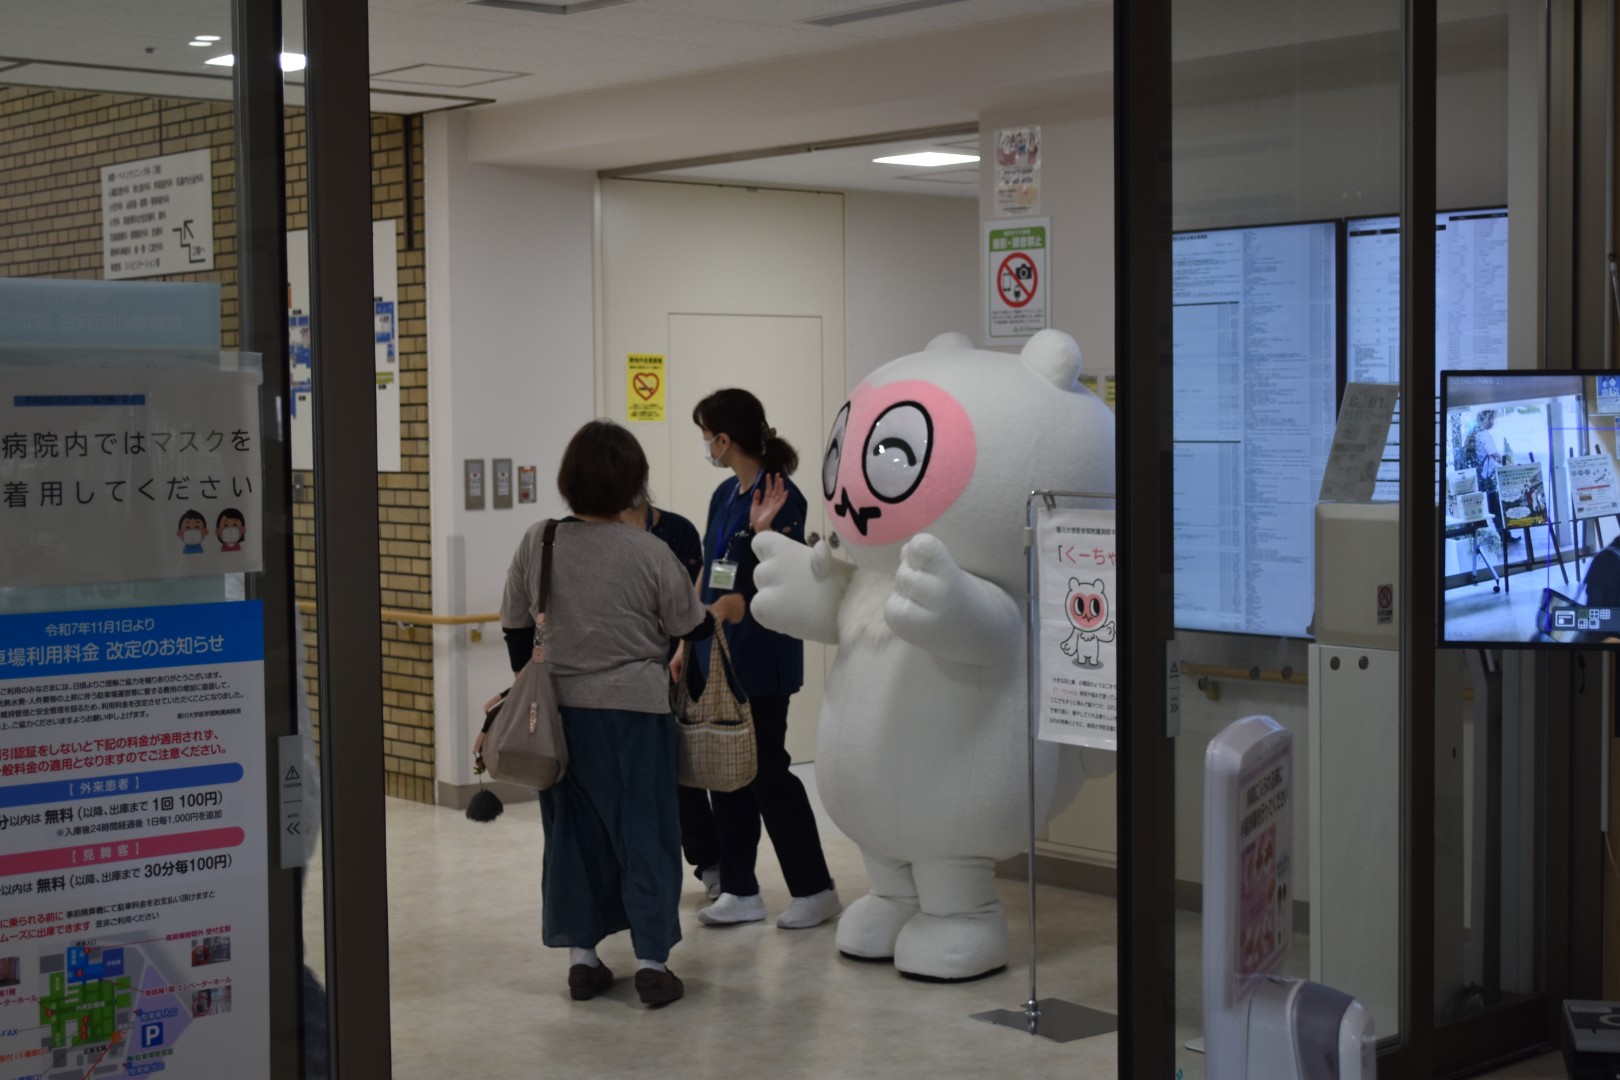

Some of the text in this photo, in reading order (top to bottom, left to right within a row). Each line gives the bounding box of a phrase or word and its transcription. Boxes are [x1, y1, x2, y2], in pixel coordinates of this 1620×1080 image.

[1, 428, 250, 459] 病院内ではマスクを
[3, 475, 253, 508] 着用してください
[44, 618, 155, 638] 令和7年11月1日より
[106, 635, 224, 660] 改定のお知らせ
[0, 672, 222, 697] ご利用のみなさまには、日頃よりご理解ご協力を賜りありがとうございます。
[0, 693, 244, 719] 維持管理と安全管理を図るため、利用料金を改定させていただくことになりました。
[0, 711, 150, 730] 上、ご協力くださいますようお願い申し上げます。
[0, 745, 227, 776] 般料金の適用となりますのでご注意ください。
[45, 807, 74, 825] 無料
[153, 796, 174, 811] 1回
[147, 810, 222, 827] 1日毎1,000円を追加
[0, 882, 33, 897] 以内は
[37, 875, 65, 894] 無料
[0, 911, 64, 929] に乗られる前に
[0, 912, 160, 943] ムーズに出庫できます 是非ご利用ください
[177, 976, 232, 993] エレベーターホール
